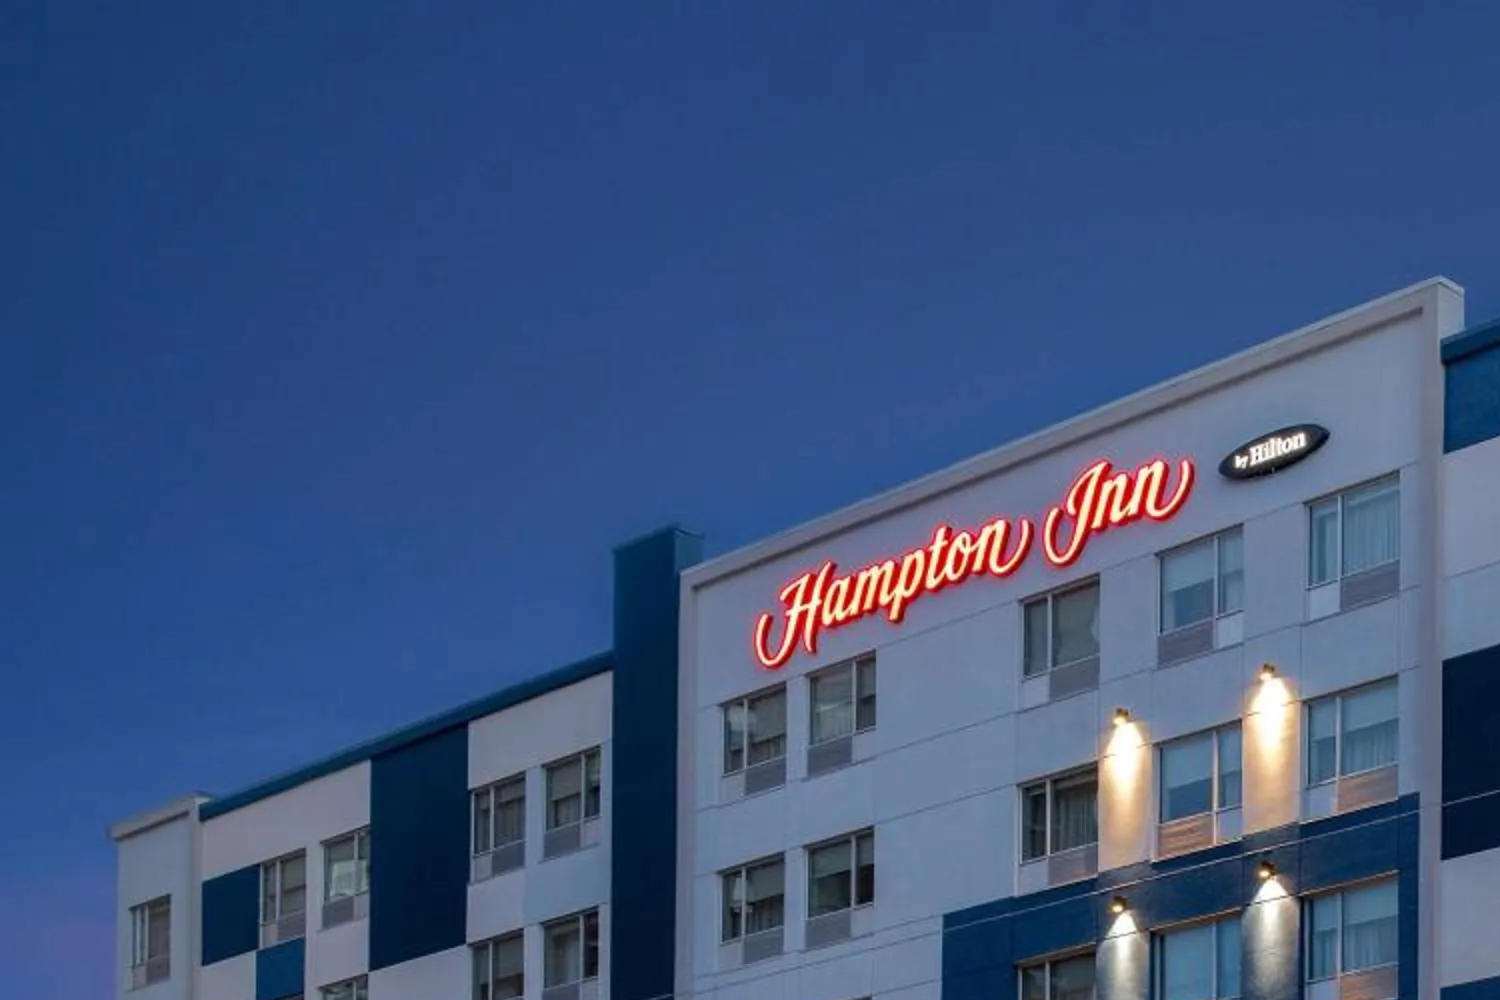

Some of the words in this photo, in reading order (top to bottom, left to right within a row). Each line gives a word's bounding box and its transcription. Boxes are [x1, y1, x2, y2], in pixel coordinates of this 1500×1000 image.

[1234, 454, 1249, 470] by
[1249, 431, 1306, 467] Hilton
[754, 516, 1034, 669] Hampton
[1042, 457, 1196, 567] Inn
